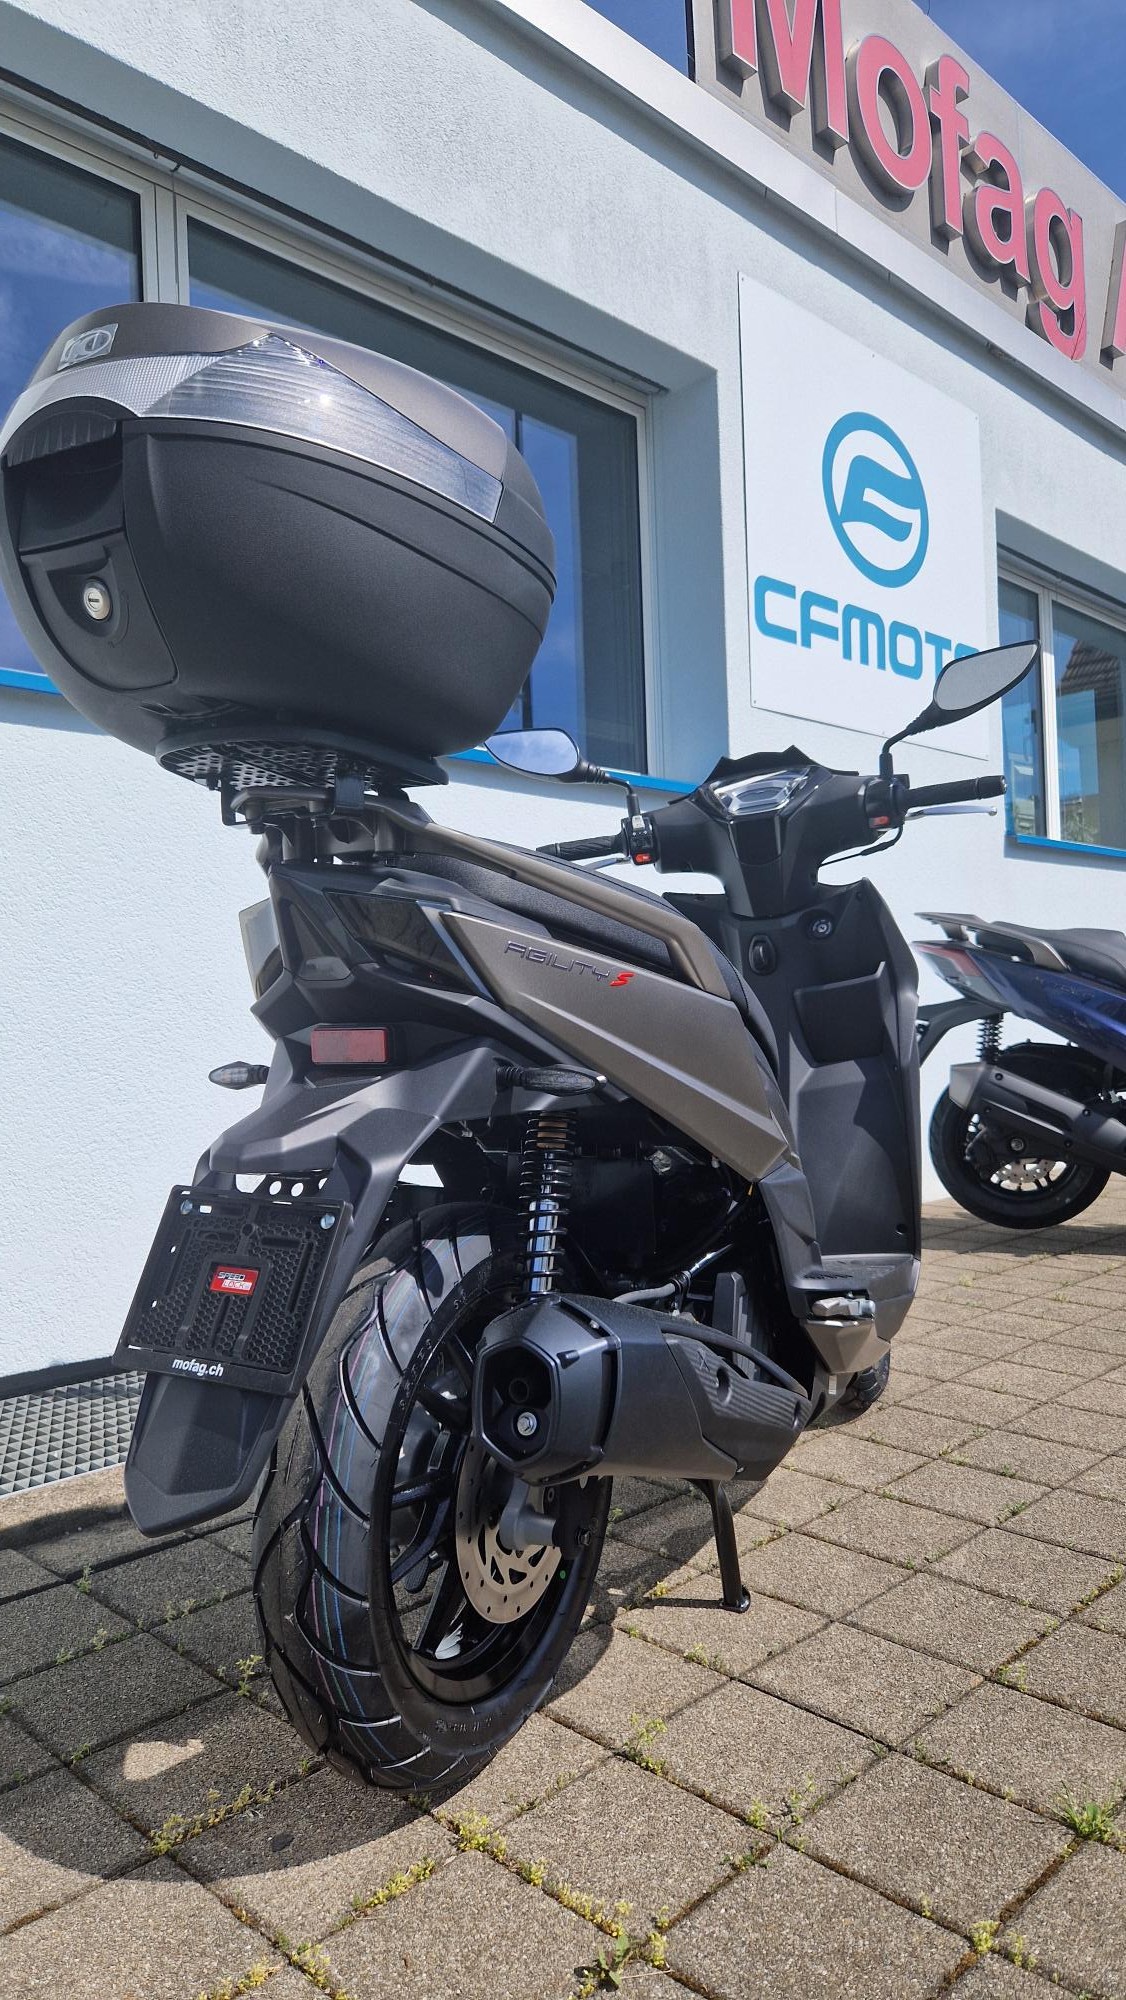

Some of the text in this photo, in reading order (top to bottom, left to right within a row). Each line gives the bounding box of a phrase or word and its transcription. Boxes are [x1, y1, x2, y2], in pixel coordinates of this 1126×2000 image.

[753, 574, 980, 683] CFMOT
[503, 940, 636, 987] AGILITY S
[171, 1358, 225, 1377] mofag.ch
